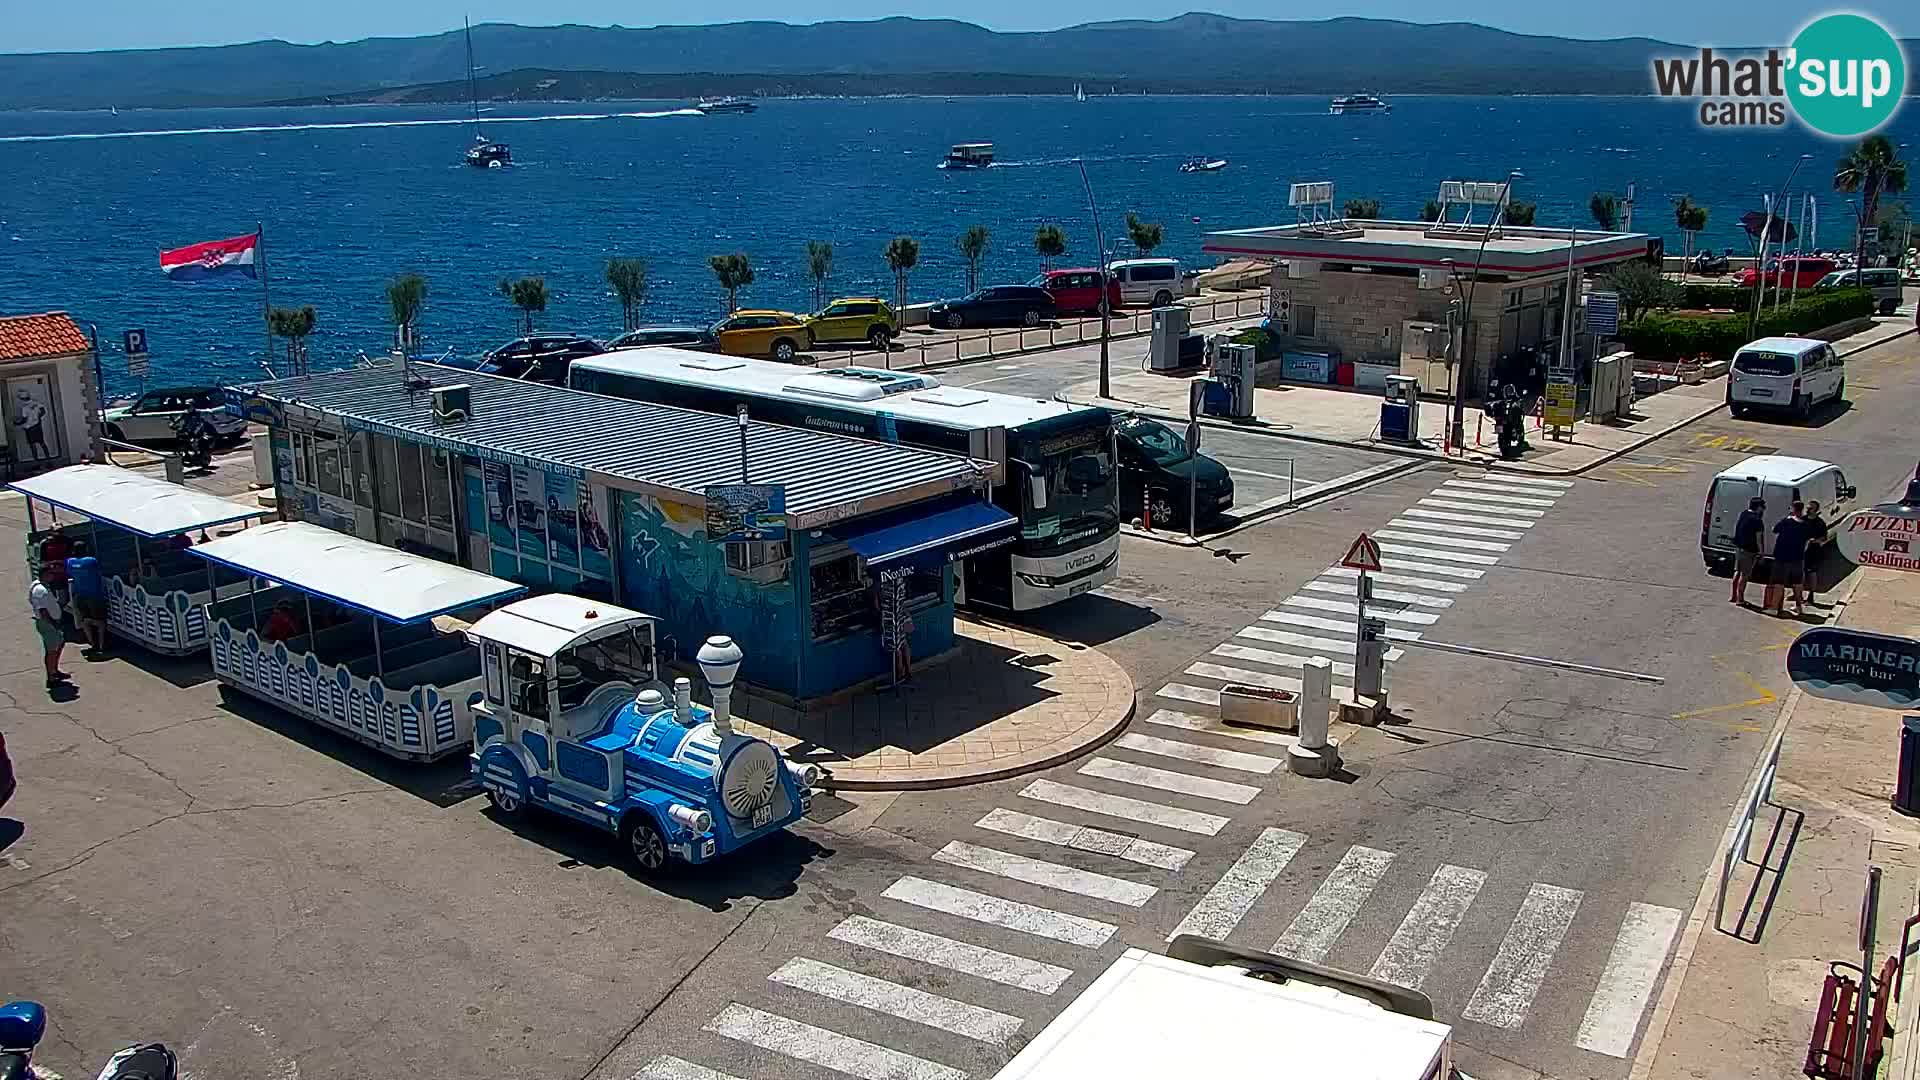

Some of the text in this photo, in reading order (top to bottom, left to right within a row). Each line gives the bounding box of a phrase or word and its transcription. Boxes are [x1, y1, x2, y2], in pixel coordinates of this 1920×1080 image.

[129, 332, 141, 351] P
[529, 458, 552, 473] TICKET
[554, 464, 582, 479] OFFICE
[1847, 516, 1920, 534] PIZZE
[1065, 553, 1096, 571] IVECO
[1870, 666, 1896, 681] bar
